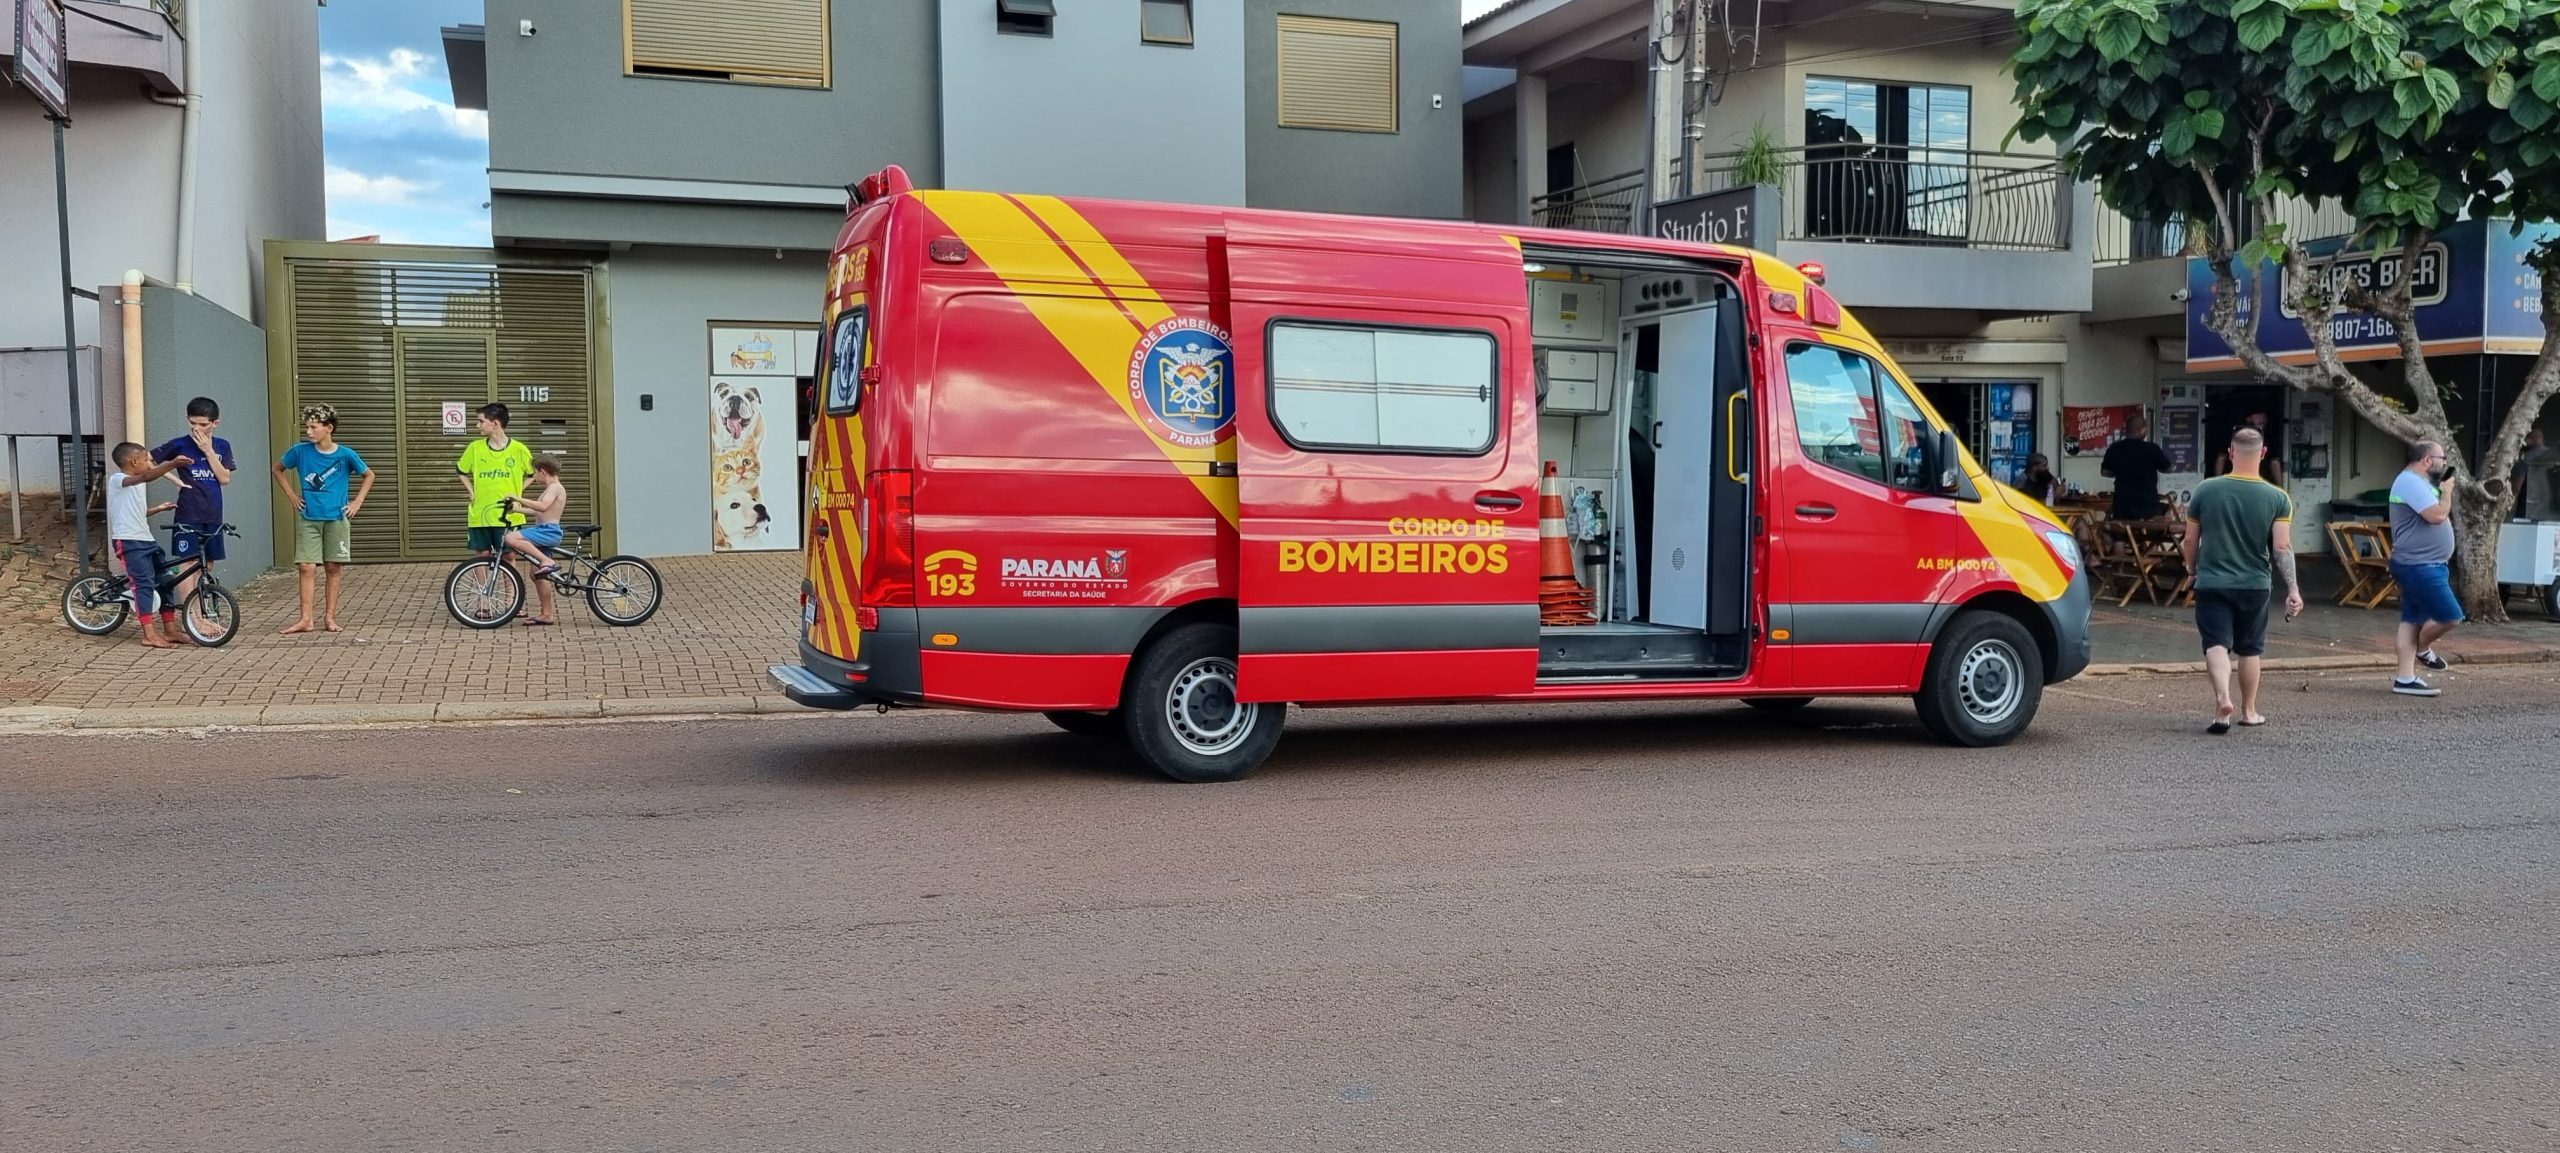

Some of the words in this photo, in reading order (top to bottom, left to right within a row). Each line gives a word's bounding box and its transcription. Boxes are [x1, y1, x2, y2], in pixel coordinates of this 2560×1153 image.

[1662, 210, 1728, 243] Studio
[1130, 350, 1145, 400] CORPO
[1141, 330, 1159, 349] DE
[1159, 317, 1233, 347] BOMBEIROS
[520, 387, 549, 402] 1115
[1170, 431, 1218, 446] PARANÁ
[479, 469, 511, 480] crefisa
[836, 493, 855, 508] 00074
[1388, 517, 1469, 537] CORPO
[1475, 519, 1505, 538] DE
[1279, 541, 1509, 574] BOMBEIROS
[1917, 557, 1934, 570] AA
[1936, 558, 1954, 570] BM
[1956, 559, 1996, 572] 00074
[1002, 557, 1102, 578] PARANÁ
[926, 573, 976, 597] 193
[1022, 590, 1068, 598] SECRETARIA
[1081, 589, 1106, 598] SAÚDE
